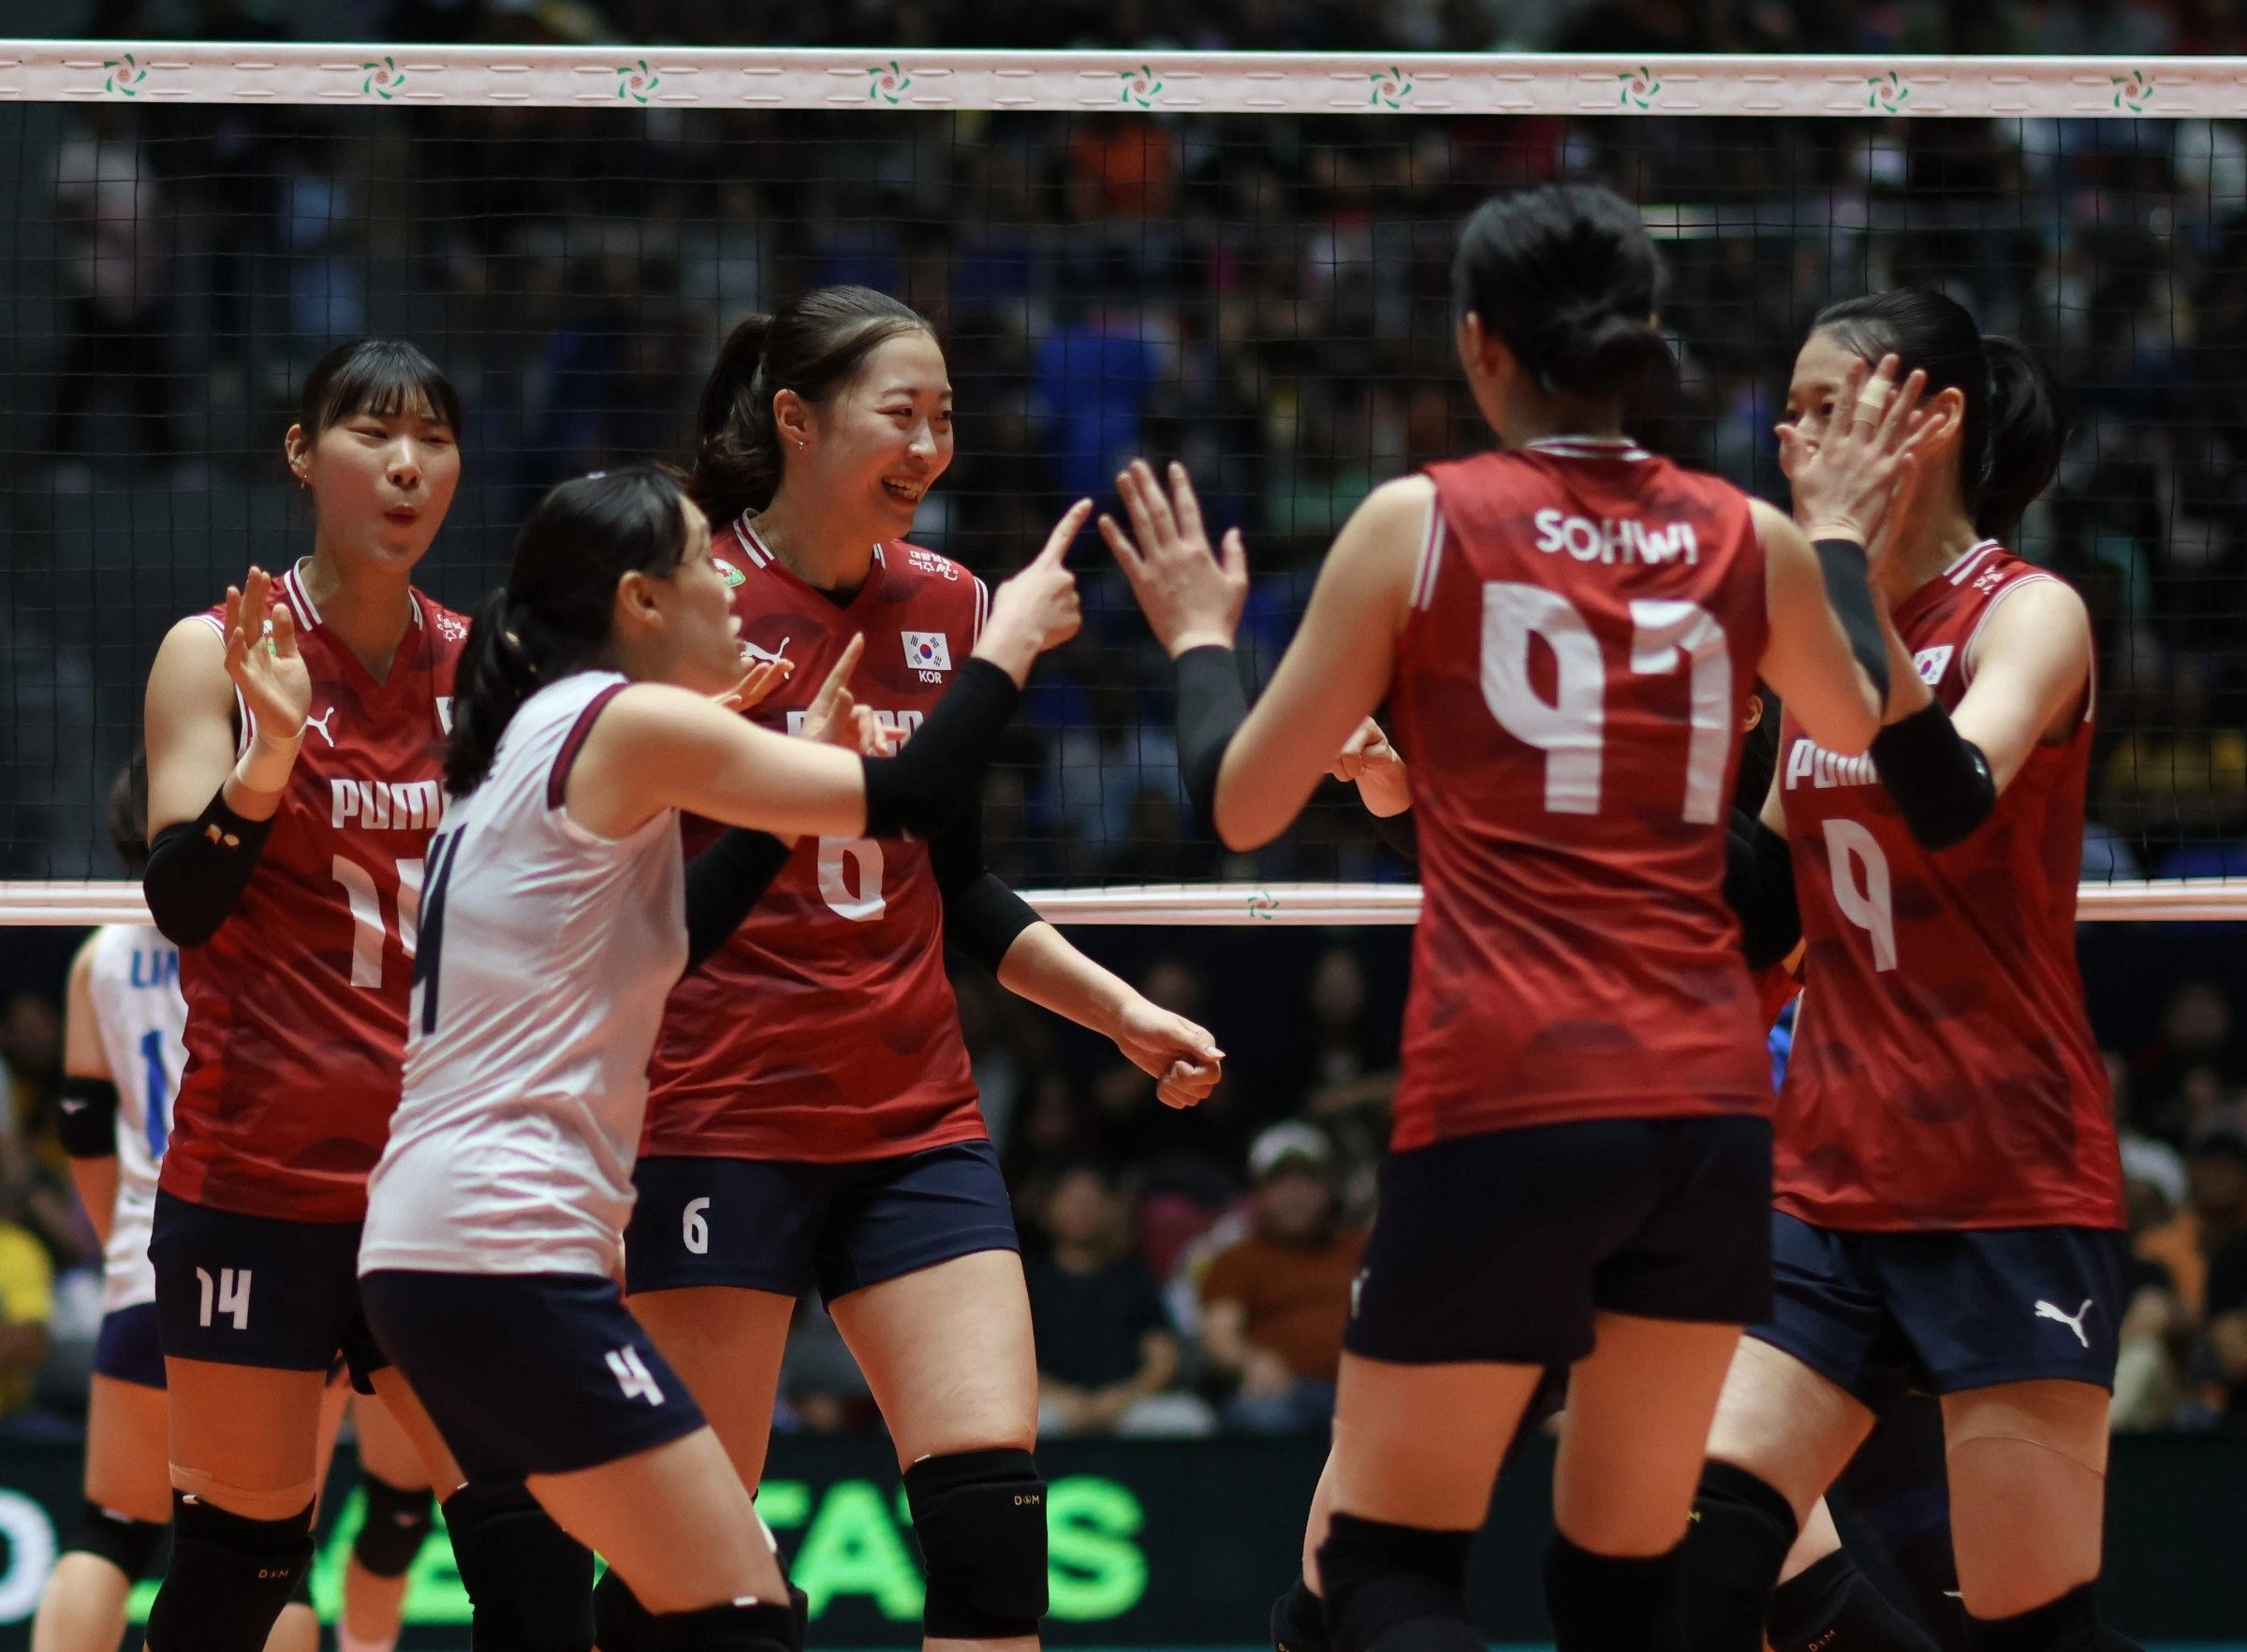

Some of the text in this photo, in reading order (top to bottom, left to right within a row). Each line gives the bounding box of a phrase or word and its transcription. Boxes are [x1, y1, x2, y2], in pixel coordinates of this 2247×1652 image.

[1535, 507, 1698, 564] SOHWI
[918, 670, 943, 685] KOR
[1480, 580, 1732, 826] 97
[1785, 738, 1878, 791] PUM
[1822, 819, 1898, 972] 9
[682, 1197, 710, 1254] 6
[197, 1266, 252, 1330] 14
[604, 1345, 665, 1406] 4
